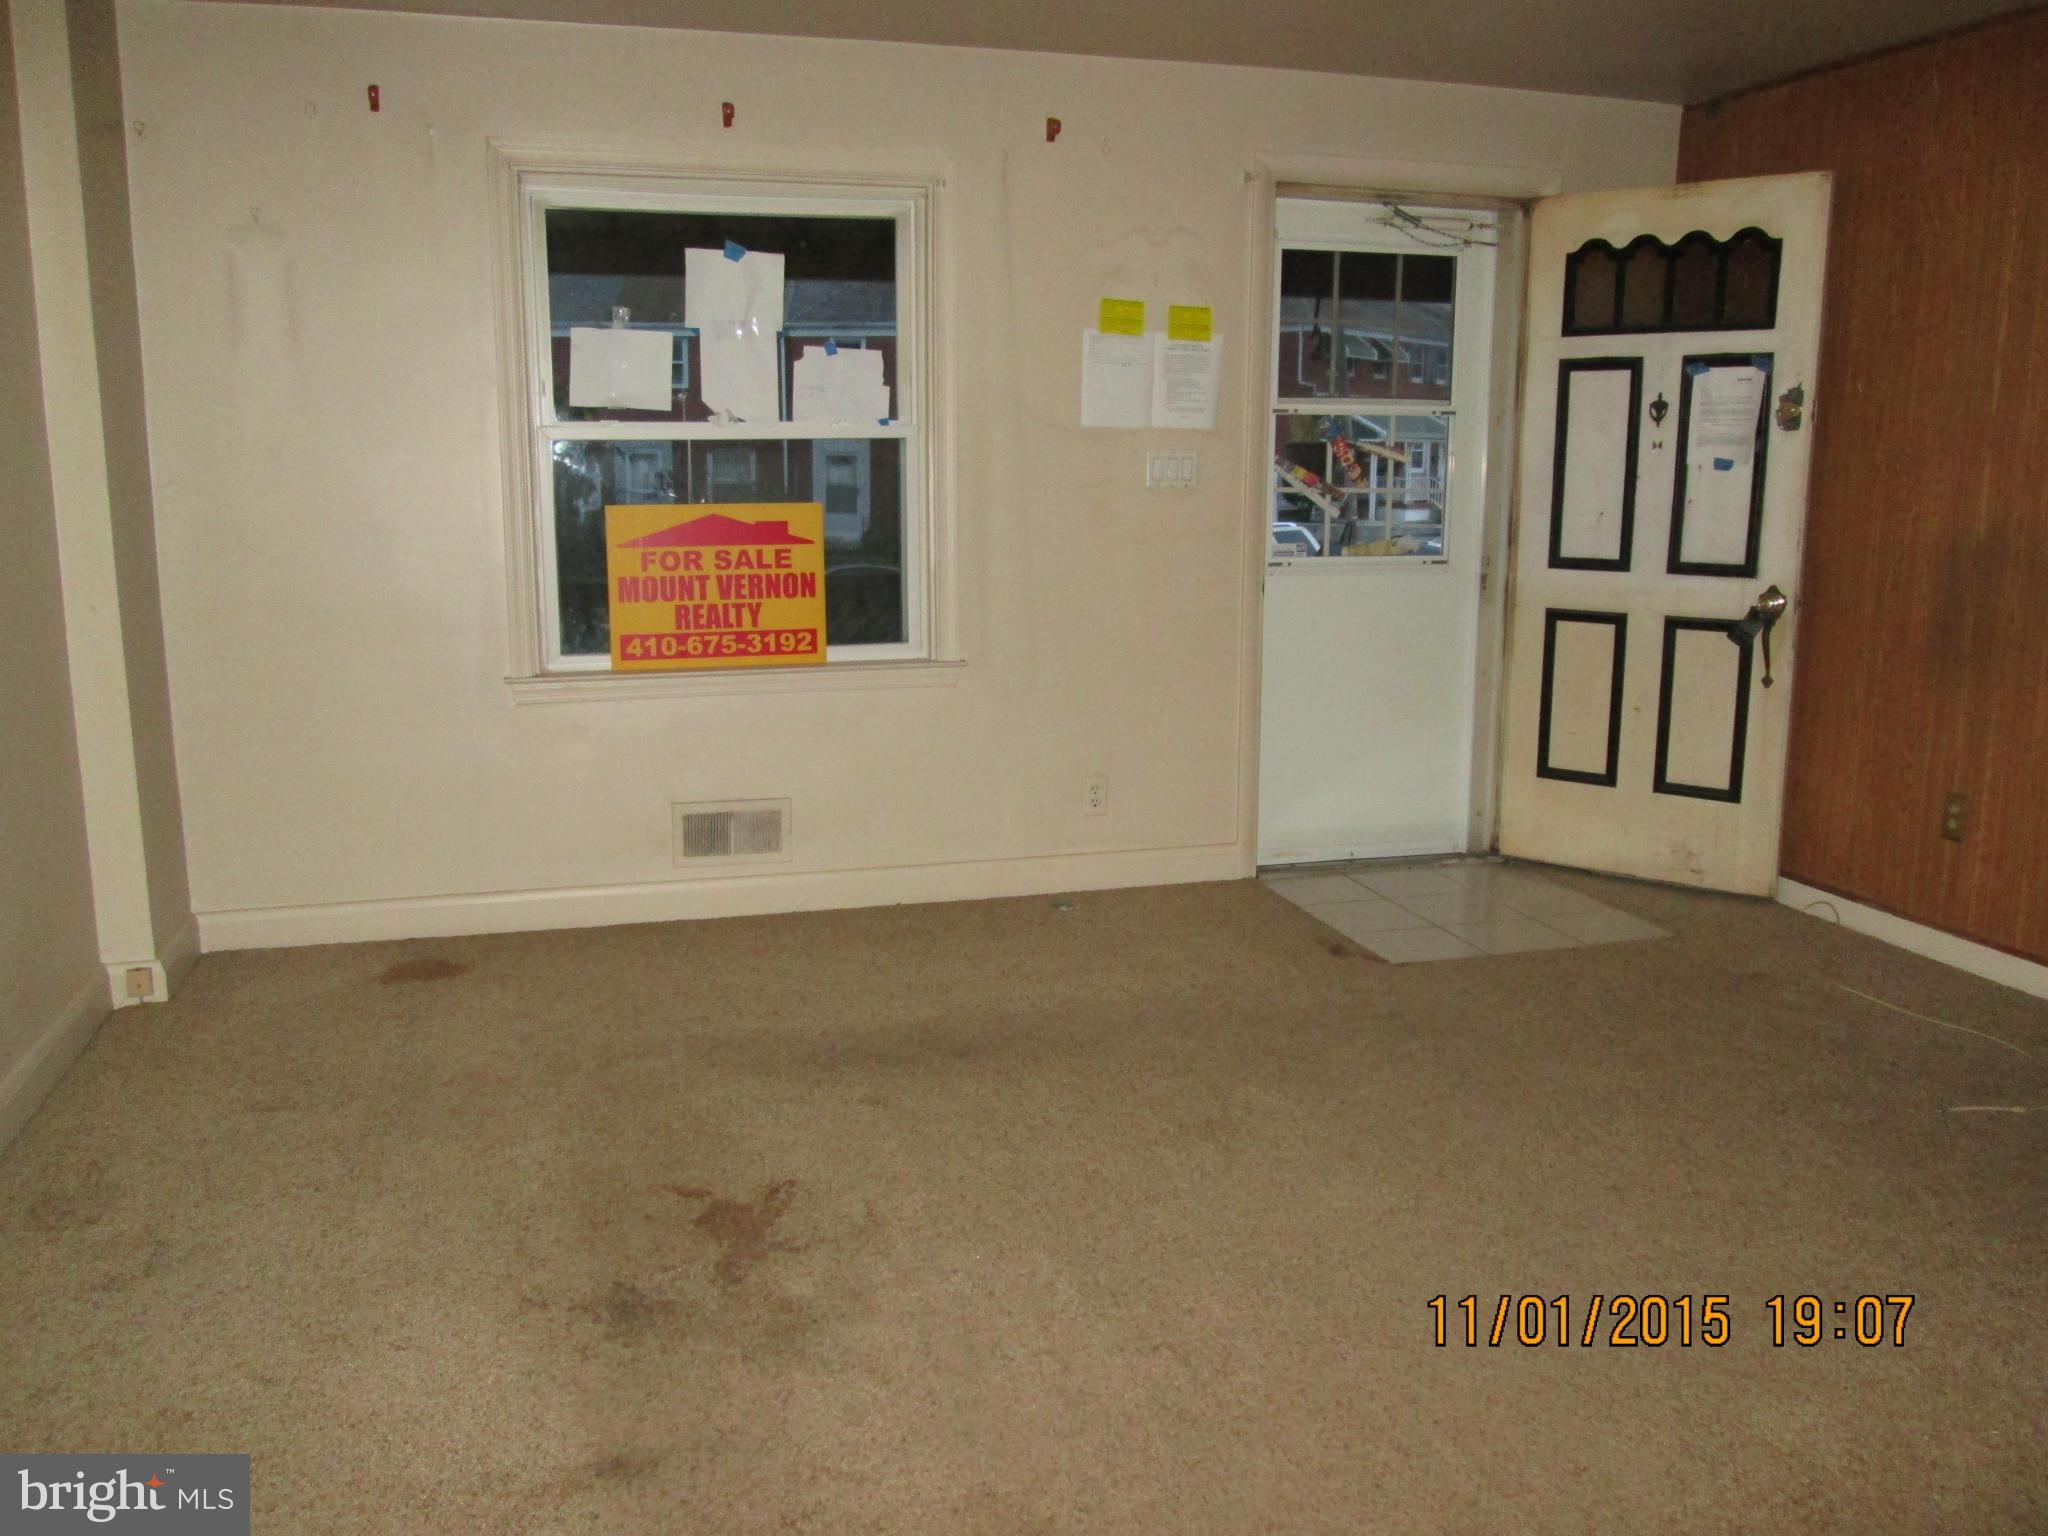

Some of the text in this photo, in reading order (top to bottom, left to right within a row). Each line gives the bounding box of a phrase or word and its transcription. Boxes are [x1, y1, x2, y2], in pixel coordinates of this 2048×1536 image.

[641, 549, 792, 572] FOR SALE
[618, 572, 817, 603] MOUNT VERNON
[674, 602, 762, 630] REALTY
[626, 632, 812, 657] 410-675-3192
